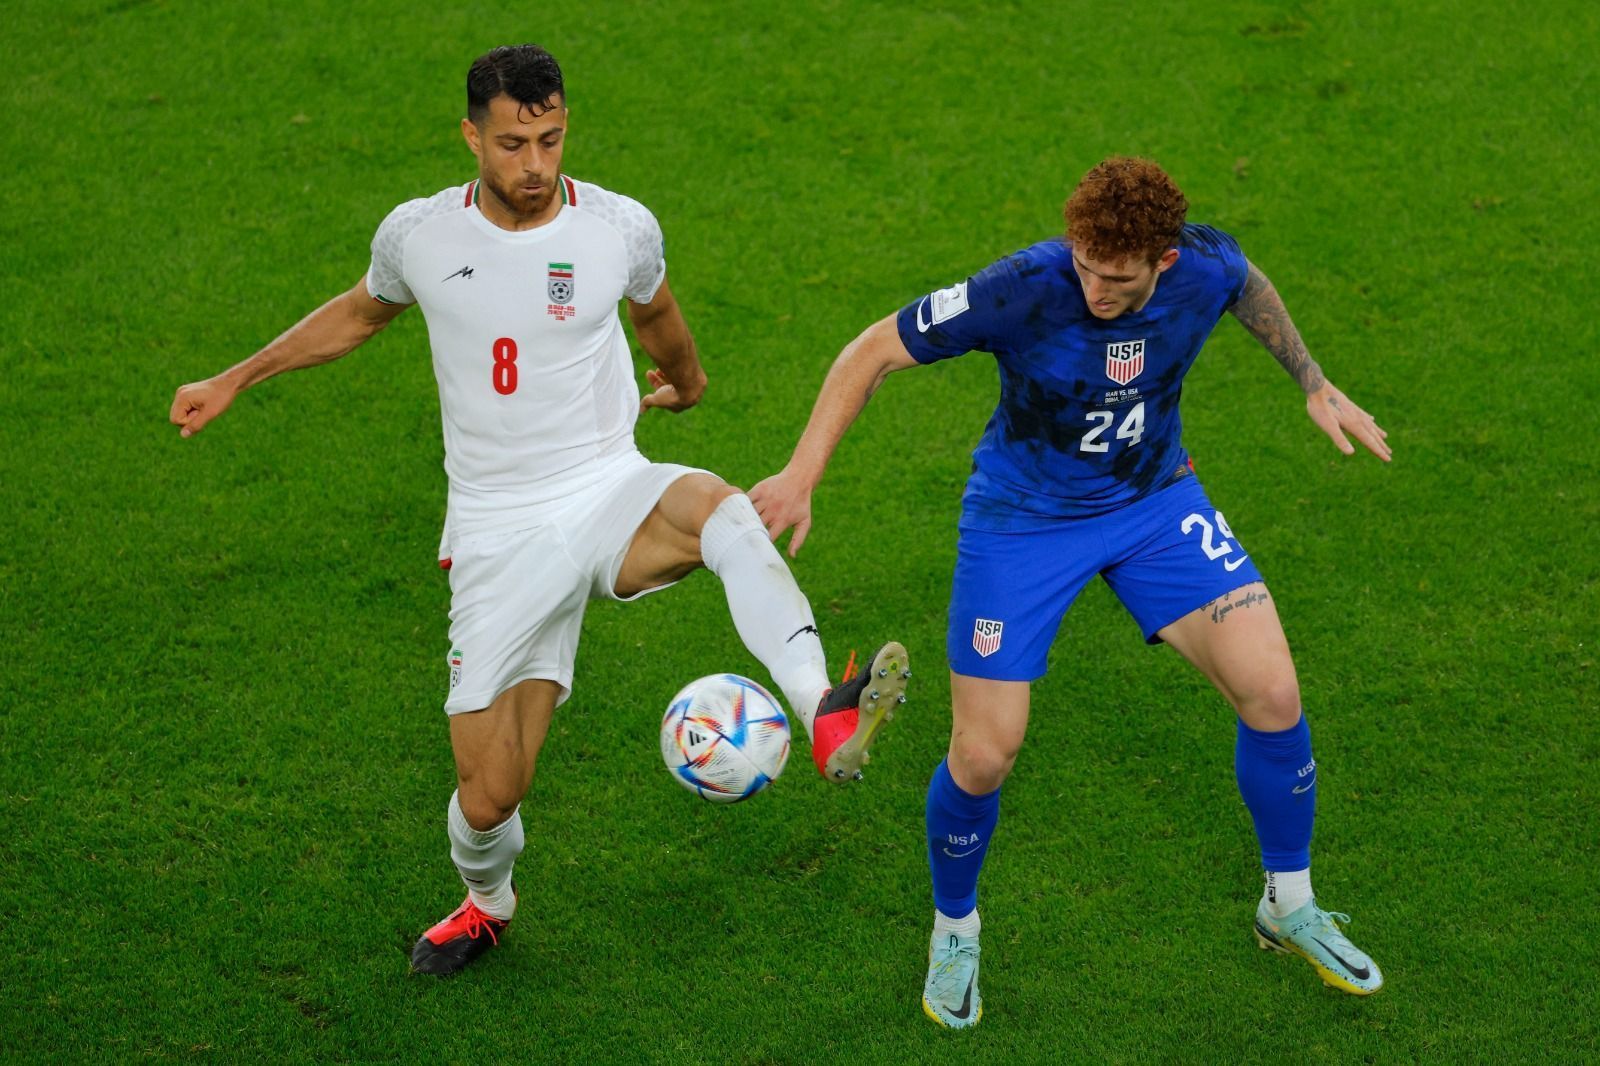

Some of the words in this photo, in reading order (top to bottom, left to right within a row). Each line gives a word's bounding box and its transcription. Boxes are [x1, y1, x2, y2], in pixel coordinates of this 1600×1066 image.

[1109, 342, 1143, 361] USA
[492, 337, 518, 396] 8
[1128, 387, 1138, 395] USA
[1080, 401, 1145, 453] 24
[977, 620, 1002, 636] USA
[948, 832, 980, 846] USA
